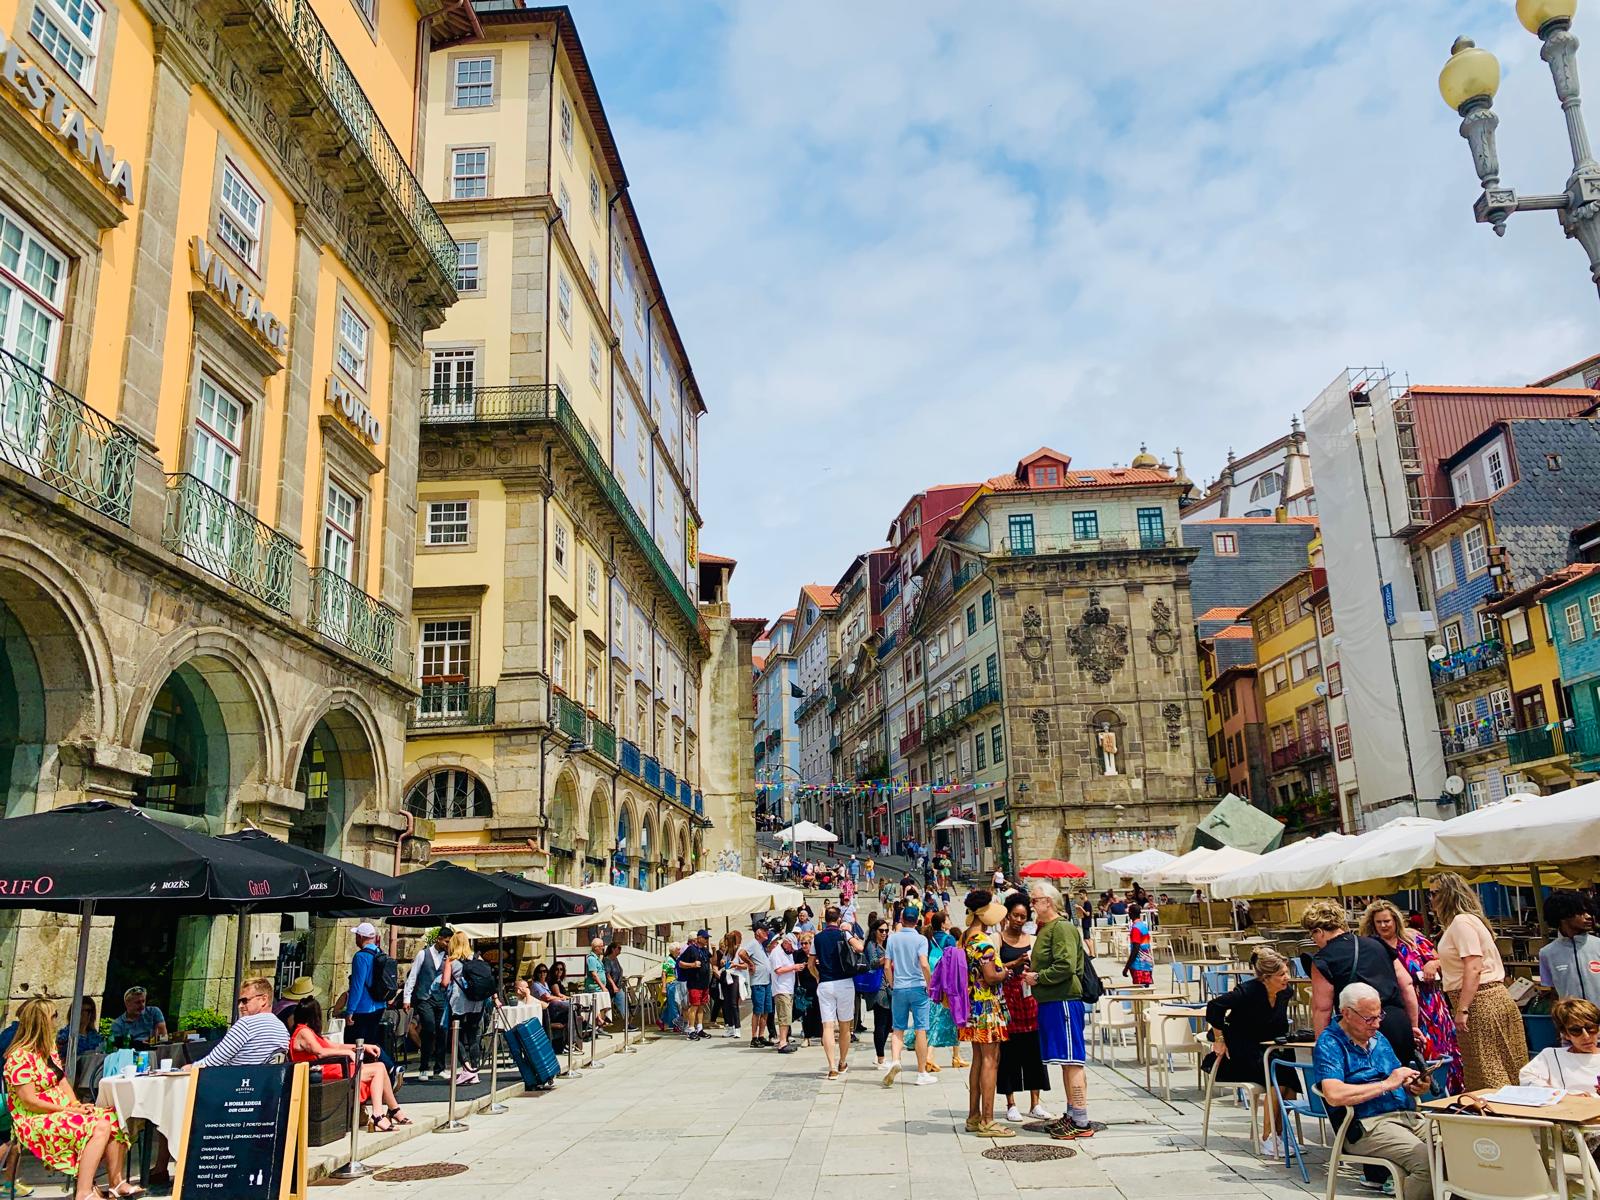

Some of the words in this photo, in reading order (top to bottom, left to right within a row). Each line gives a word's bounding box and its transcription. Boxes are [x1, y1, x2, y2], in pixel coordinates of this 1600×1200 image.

[193, 236, 289, 356] VINTAGE
[328, 376, 382, 445] PORTO
[0, 876, 54, 895] RIFO
[161, 879, 190, 889] ROZÈS
[248, 879, 271, 896] GRIFO
[310, 882, 328, 890] OZÈS
[392, 904, 431, 916] GRIFO
[241, 1078, 251, 1087] H
